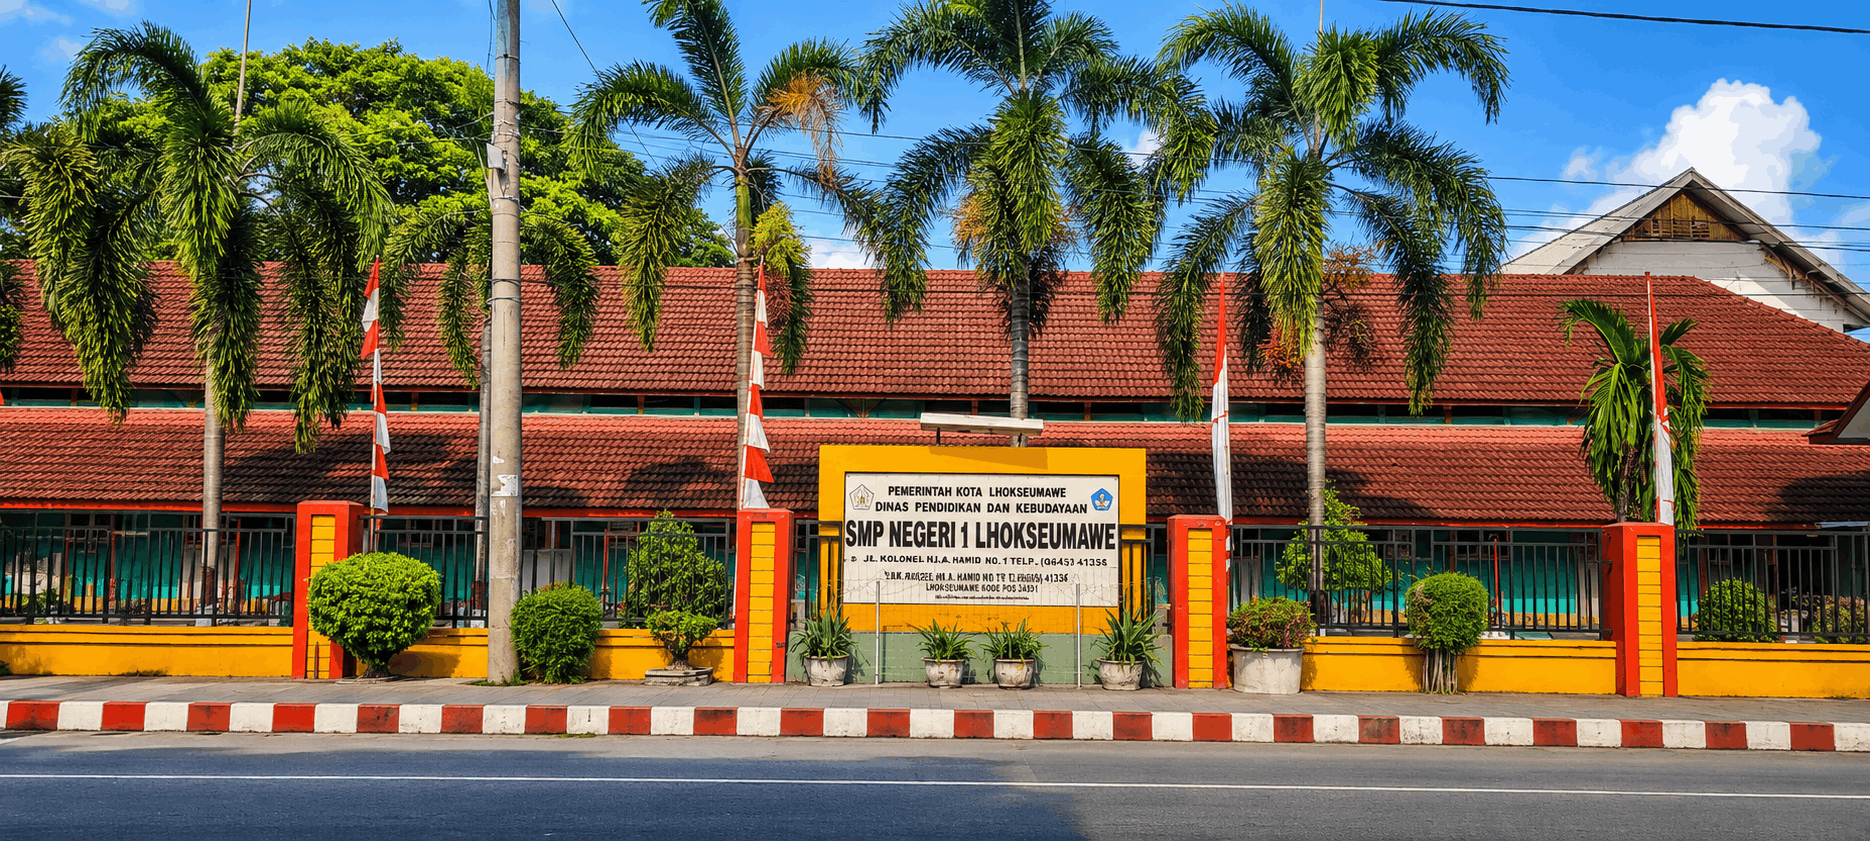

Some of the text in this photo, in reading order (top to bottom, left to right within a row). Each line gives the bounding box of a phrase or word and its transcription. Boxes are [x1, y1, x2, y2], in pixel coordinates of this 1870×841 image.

[888, 486, 1067, 498] PEMERINTAH KOTA LHOKSEUMAWE
[875, 501, 1088, 514] DINAS PENDIDIKAN DAN KEBUDAYAAN
[845, 519, 1116, 550] SMP NEGERI 1 LHOKSEUMAWE
[863, 555, 878, 563] JL.
[880, 555, 925, 563] KOLONEL
[952, 556, 981, 564] HAMID
[985, 556, 1001, 565] NO.
[1002, 557, 1008, 565] 1
